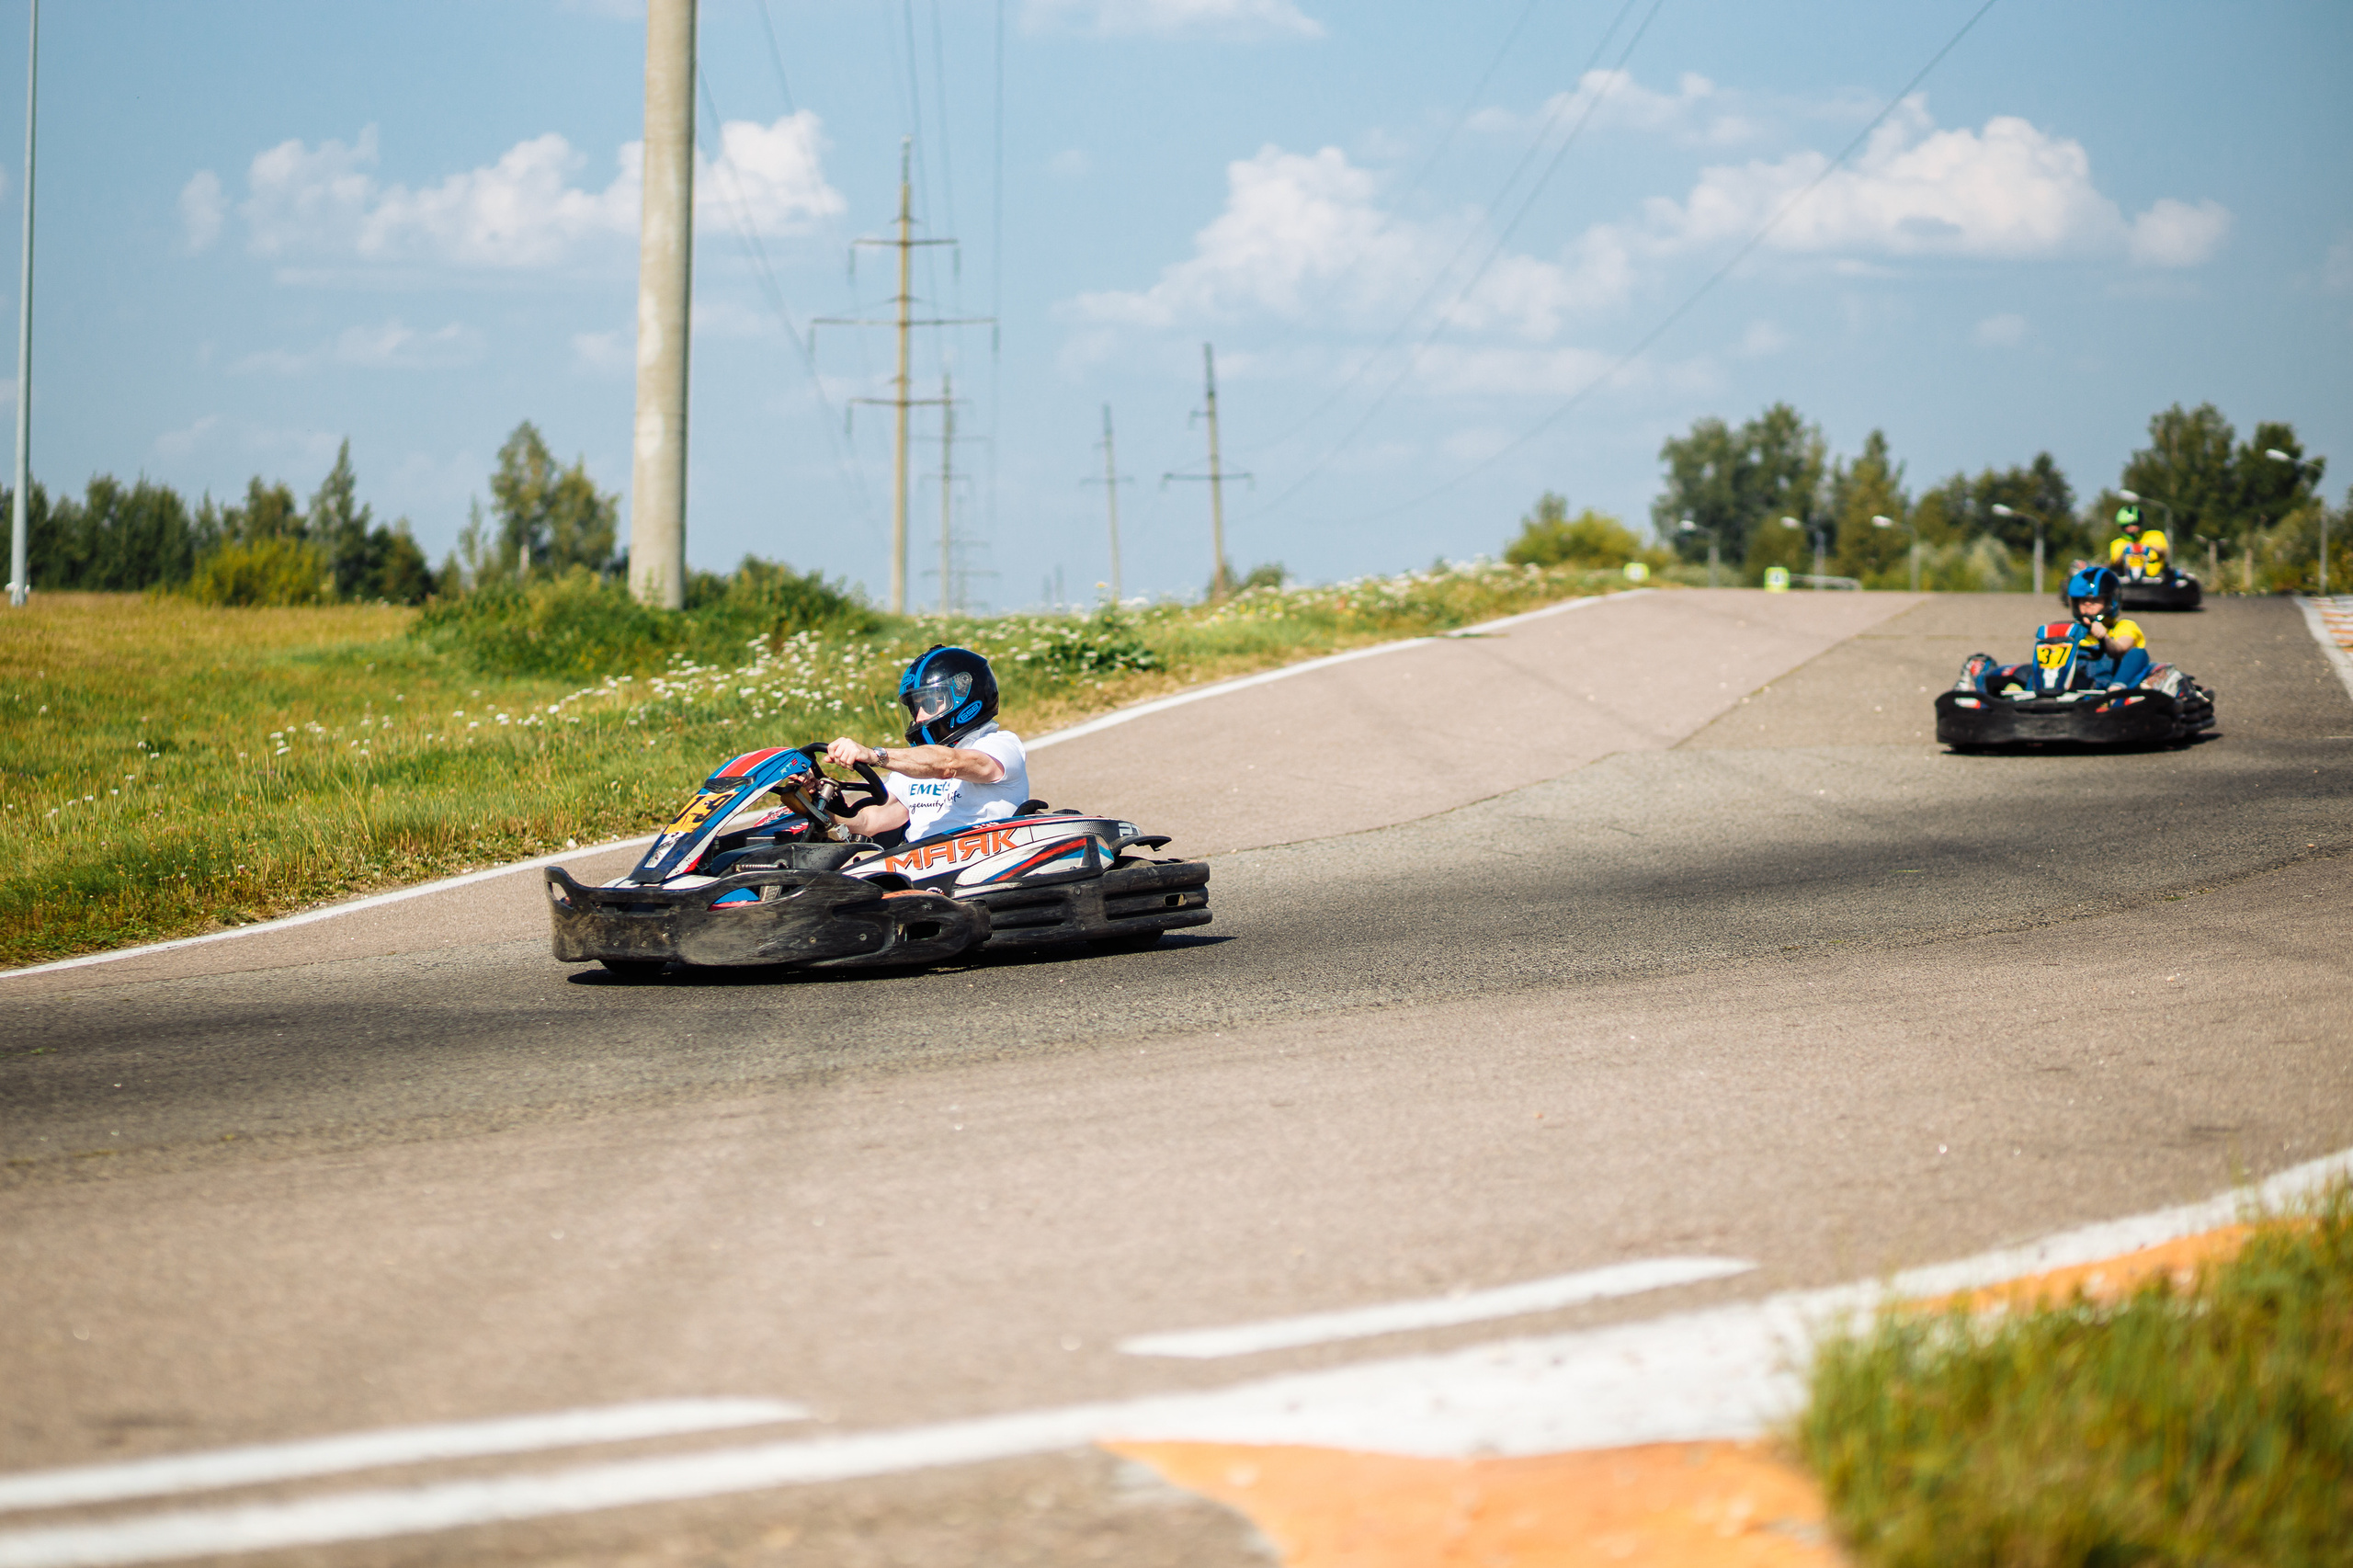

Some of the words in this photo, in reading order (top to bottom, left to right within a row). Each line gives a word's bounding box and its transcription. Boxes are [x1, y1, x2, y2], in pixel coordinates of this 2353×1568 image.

[2038, 647, 2068, 665] 37
[947, 790, 962, 802] life
[884, 828, 1017, 872] МАЯК
